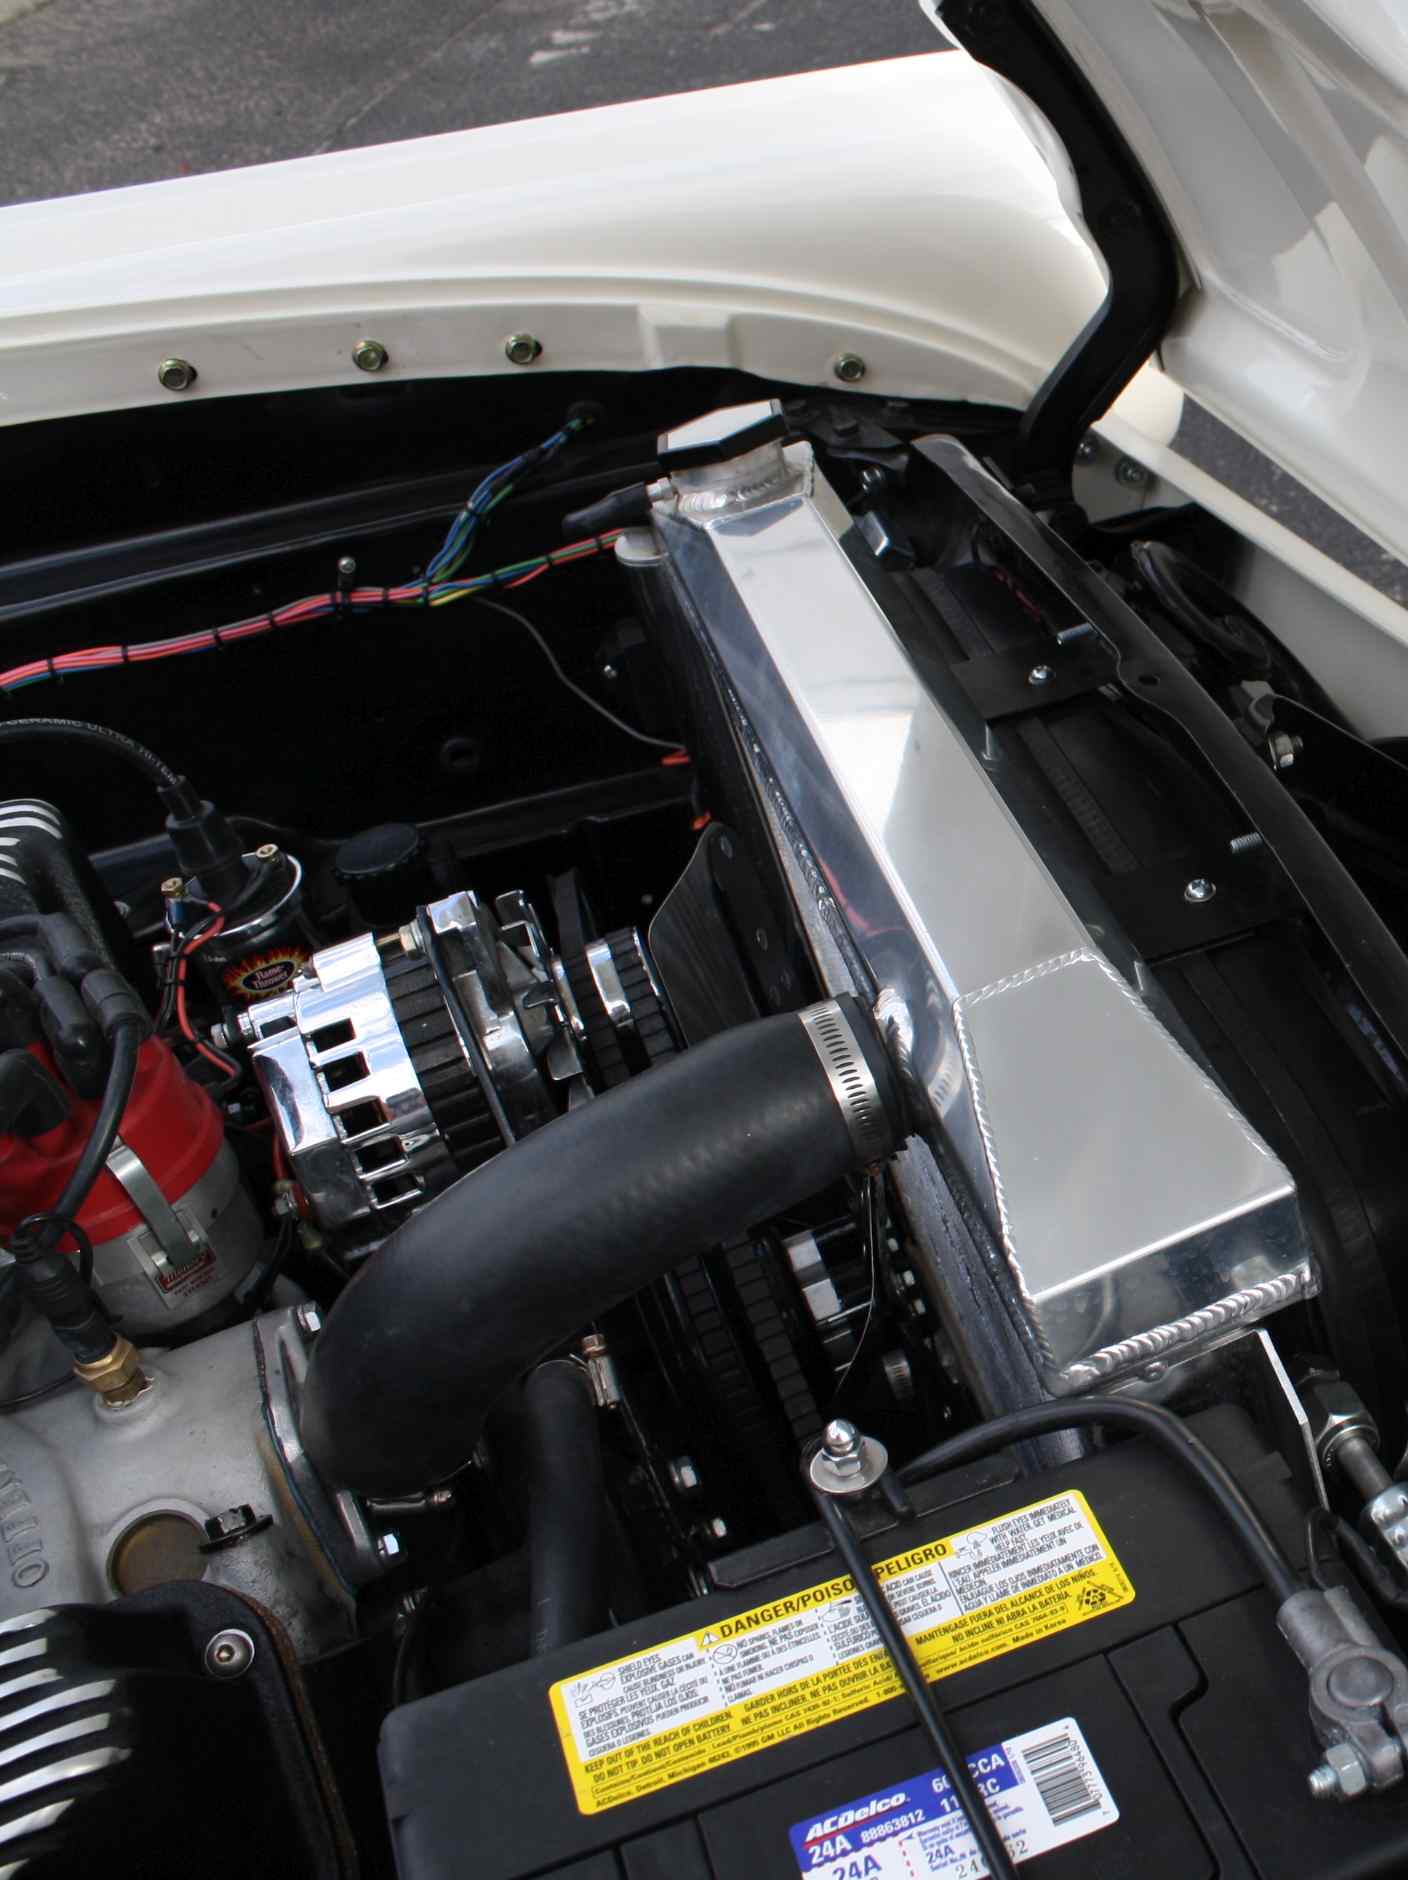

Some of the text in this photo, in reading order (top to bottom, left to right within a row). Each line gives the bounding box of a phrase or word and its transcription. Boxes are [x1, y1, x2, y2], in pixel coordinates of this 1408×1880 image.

[718, 1542, 947, 1639] DANGER/POISO PELIGRO
[657, 1654, 681, 1671] GASES
[662, 1695, 678, 1709] LOS
[584, 1725, 692, 1774] KEEP OUT OF THE REACH OF
[592, 1771, 606, 1784] DO
[606, 1763, 624, 1779] NOT
[639, 1752, 654, 1765] DO
[653, 1745, 672, 1760] NOT
[671, 1735, 695, 1753] OPEN
[800, 1788, 909, 1843] ACDelco
[805, 1831, 853, 1866] 24A
[924, 1842, 955, 1864] 24A
